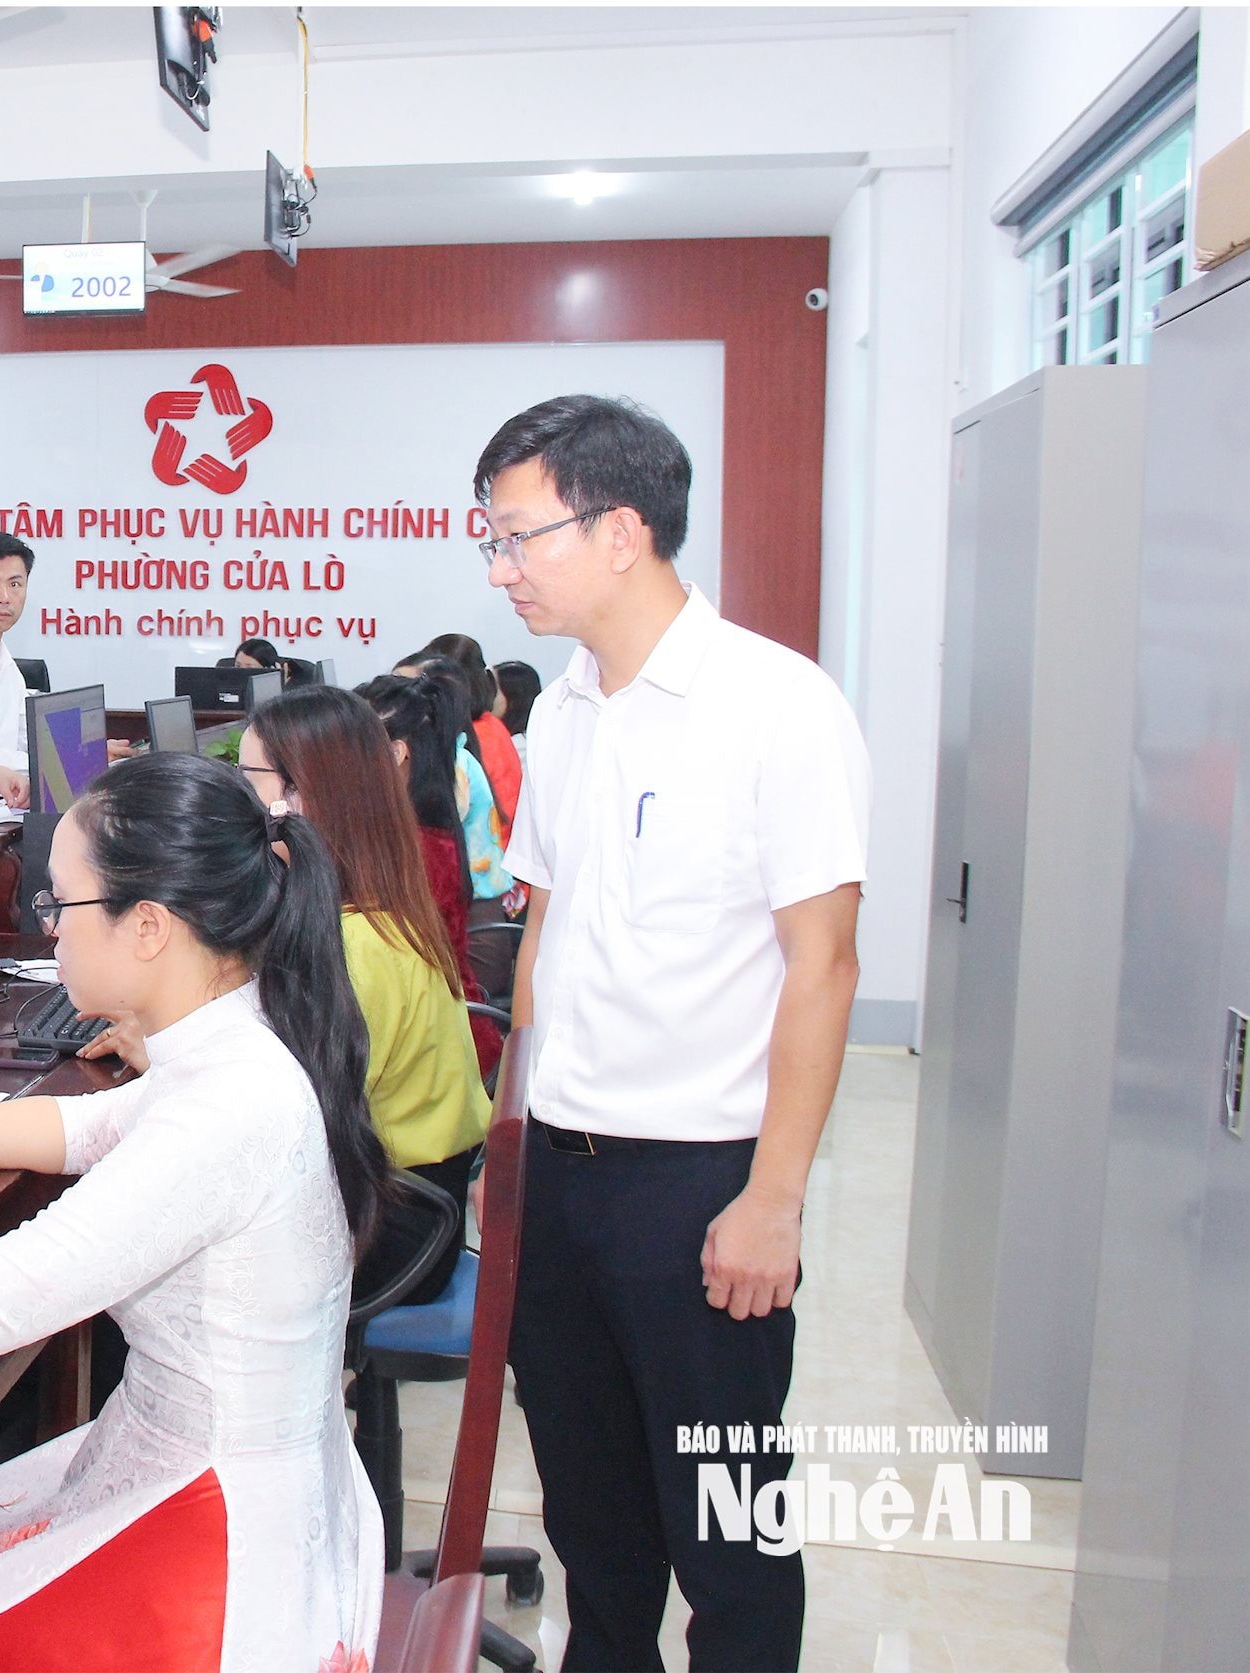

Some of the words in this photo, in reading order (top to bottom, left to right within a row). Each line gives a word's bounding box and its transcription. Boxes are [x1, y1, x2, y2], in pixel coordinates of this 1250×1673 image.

[71, 276, 131, 297] 2002
[78, 507, 165, 546] PHỤC
[179, 507, 225, 546] VỤ
[235, 500, 329, 539] HÀNH
[343, 499, 449, 539] CHÍNH
[466, 507, 488, 539] C
[75, 551, 209, 591] PHƯỜNG
[223, 550, 290, 591] CỬA
[302, 553, 346, 592] LÒ
[40, 607, 122, 636] Hành
[136, 608, 224, 637] chính
[240, 609, 323, 645] phục
[336, 616, 377, 646] vụ
